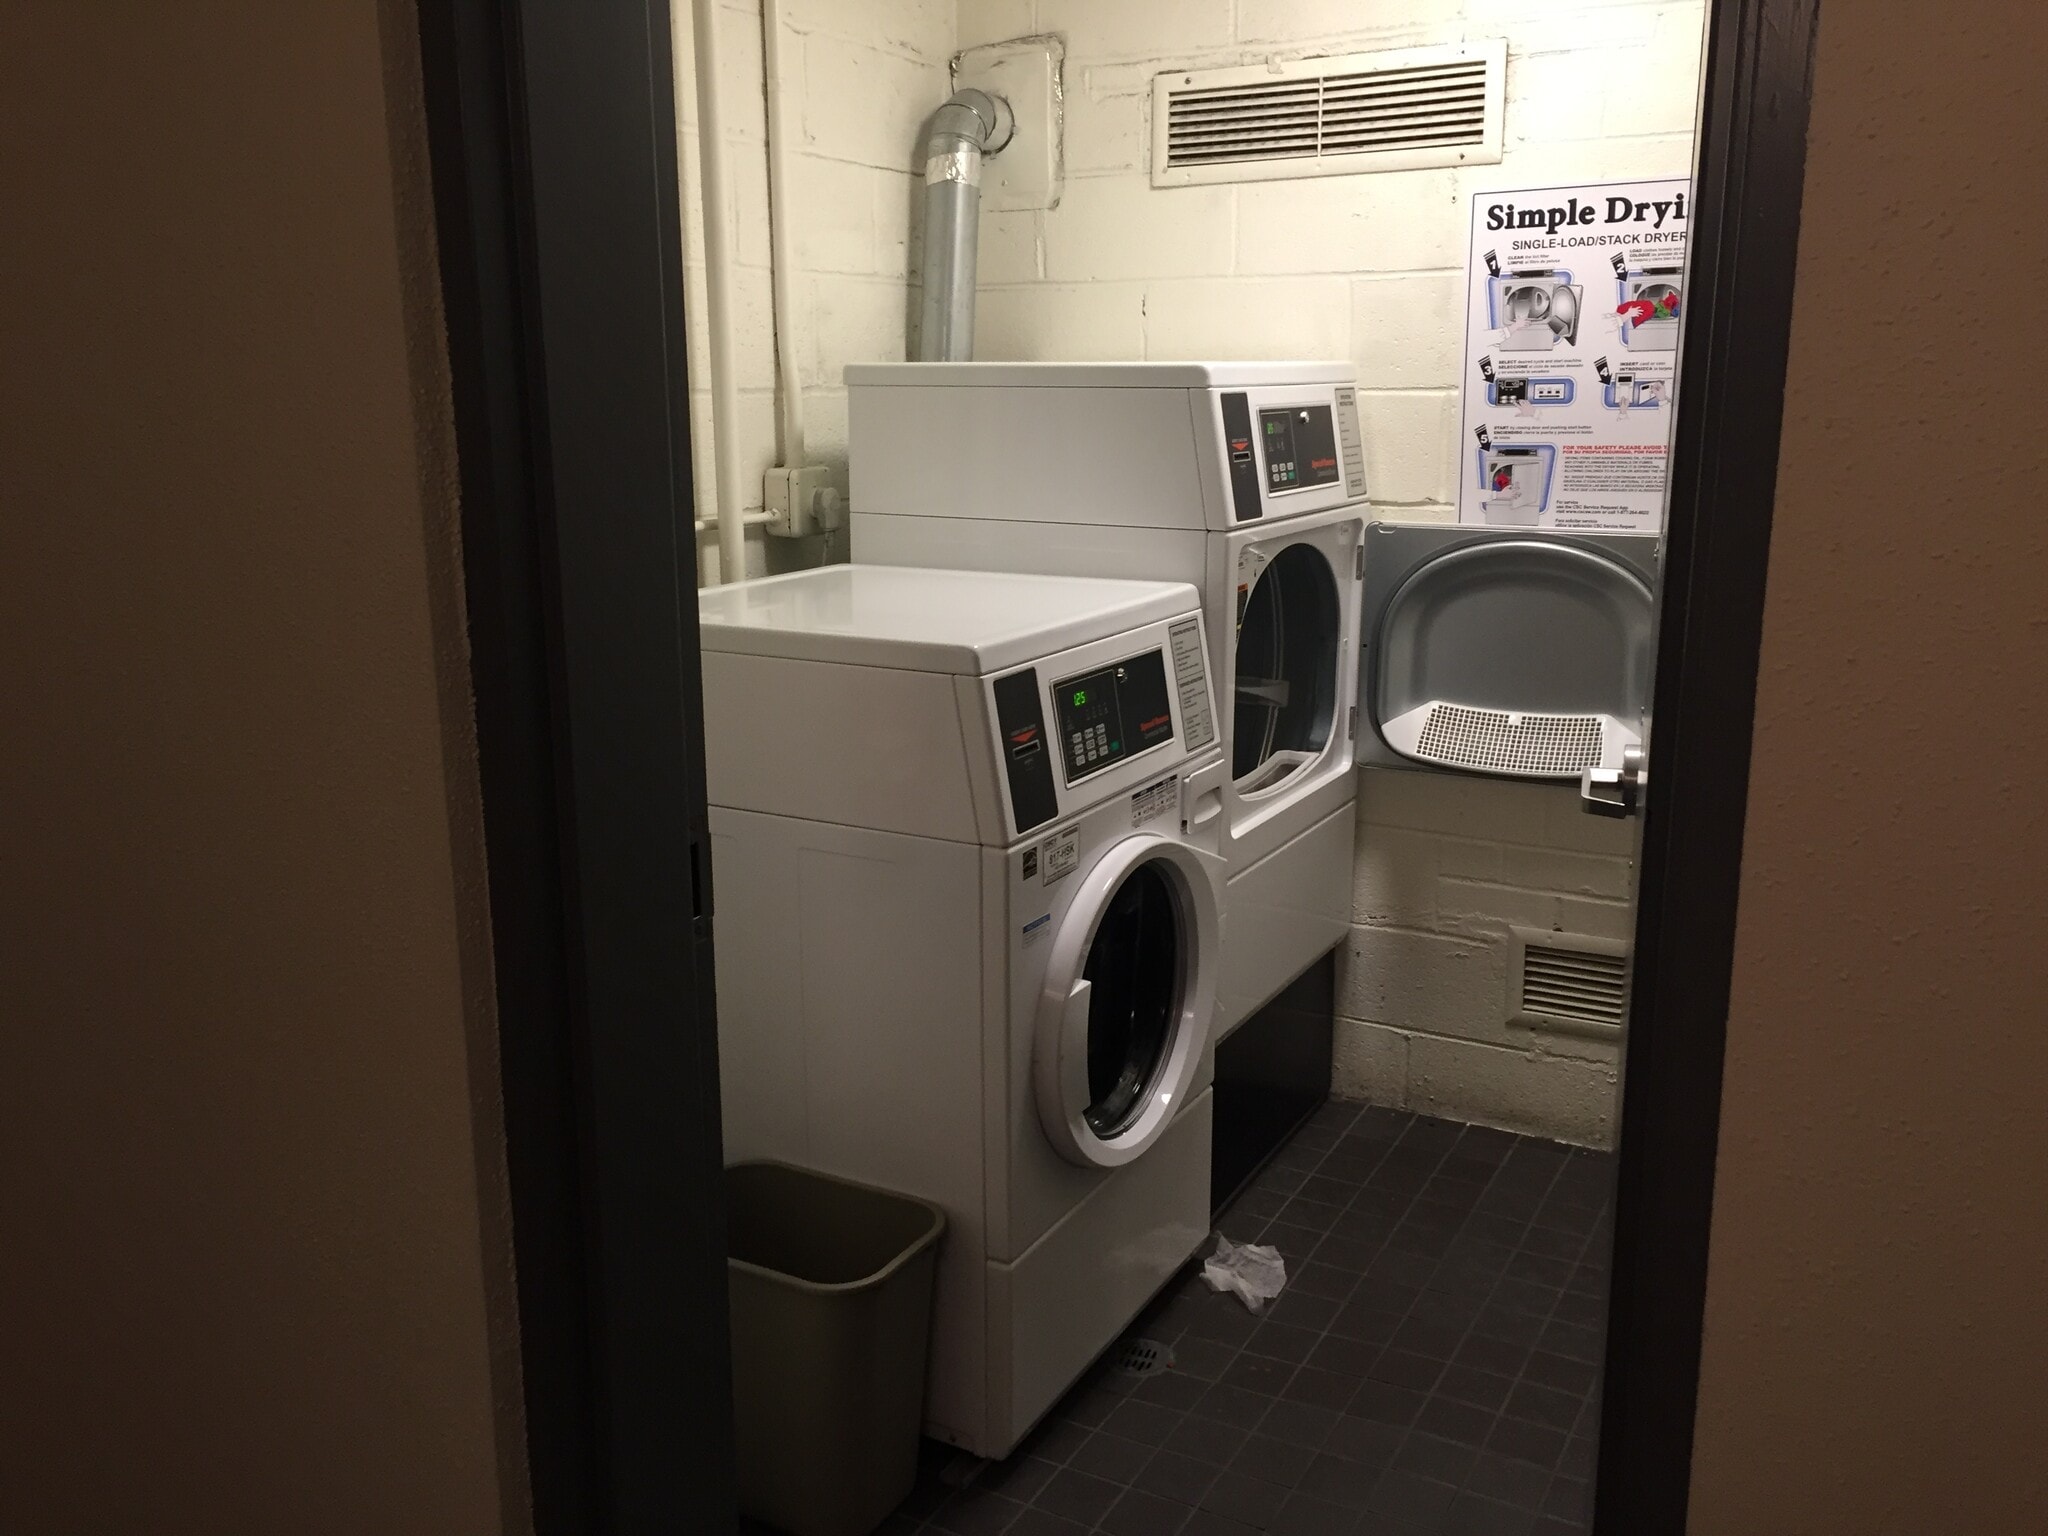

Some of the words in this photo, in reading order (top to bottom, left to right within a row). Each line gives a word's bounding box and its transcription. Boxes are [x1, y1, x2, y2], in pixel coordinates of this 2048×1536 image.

[1487, 198, 1595, 234] Simple
[1604, 193, 1685, 229] Dryi
[1512, 233, 1640, 250] SINGLE-LOAD/STACK
[1490, 260, 1496, 270] 1
[1616, 263, 1624, 273] 2
[1484, 365, 1492, 376] 3
[1600, 367, 1608, 377] 4
[1480, 434, 1488, 444] 5
